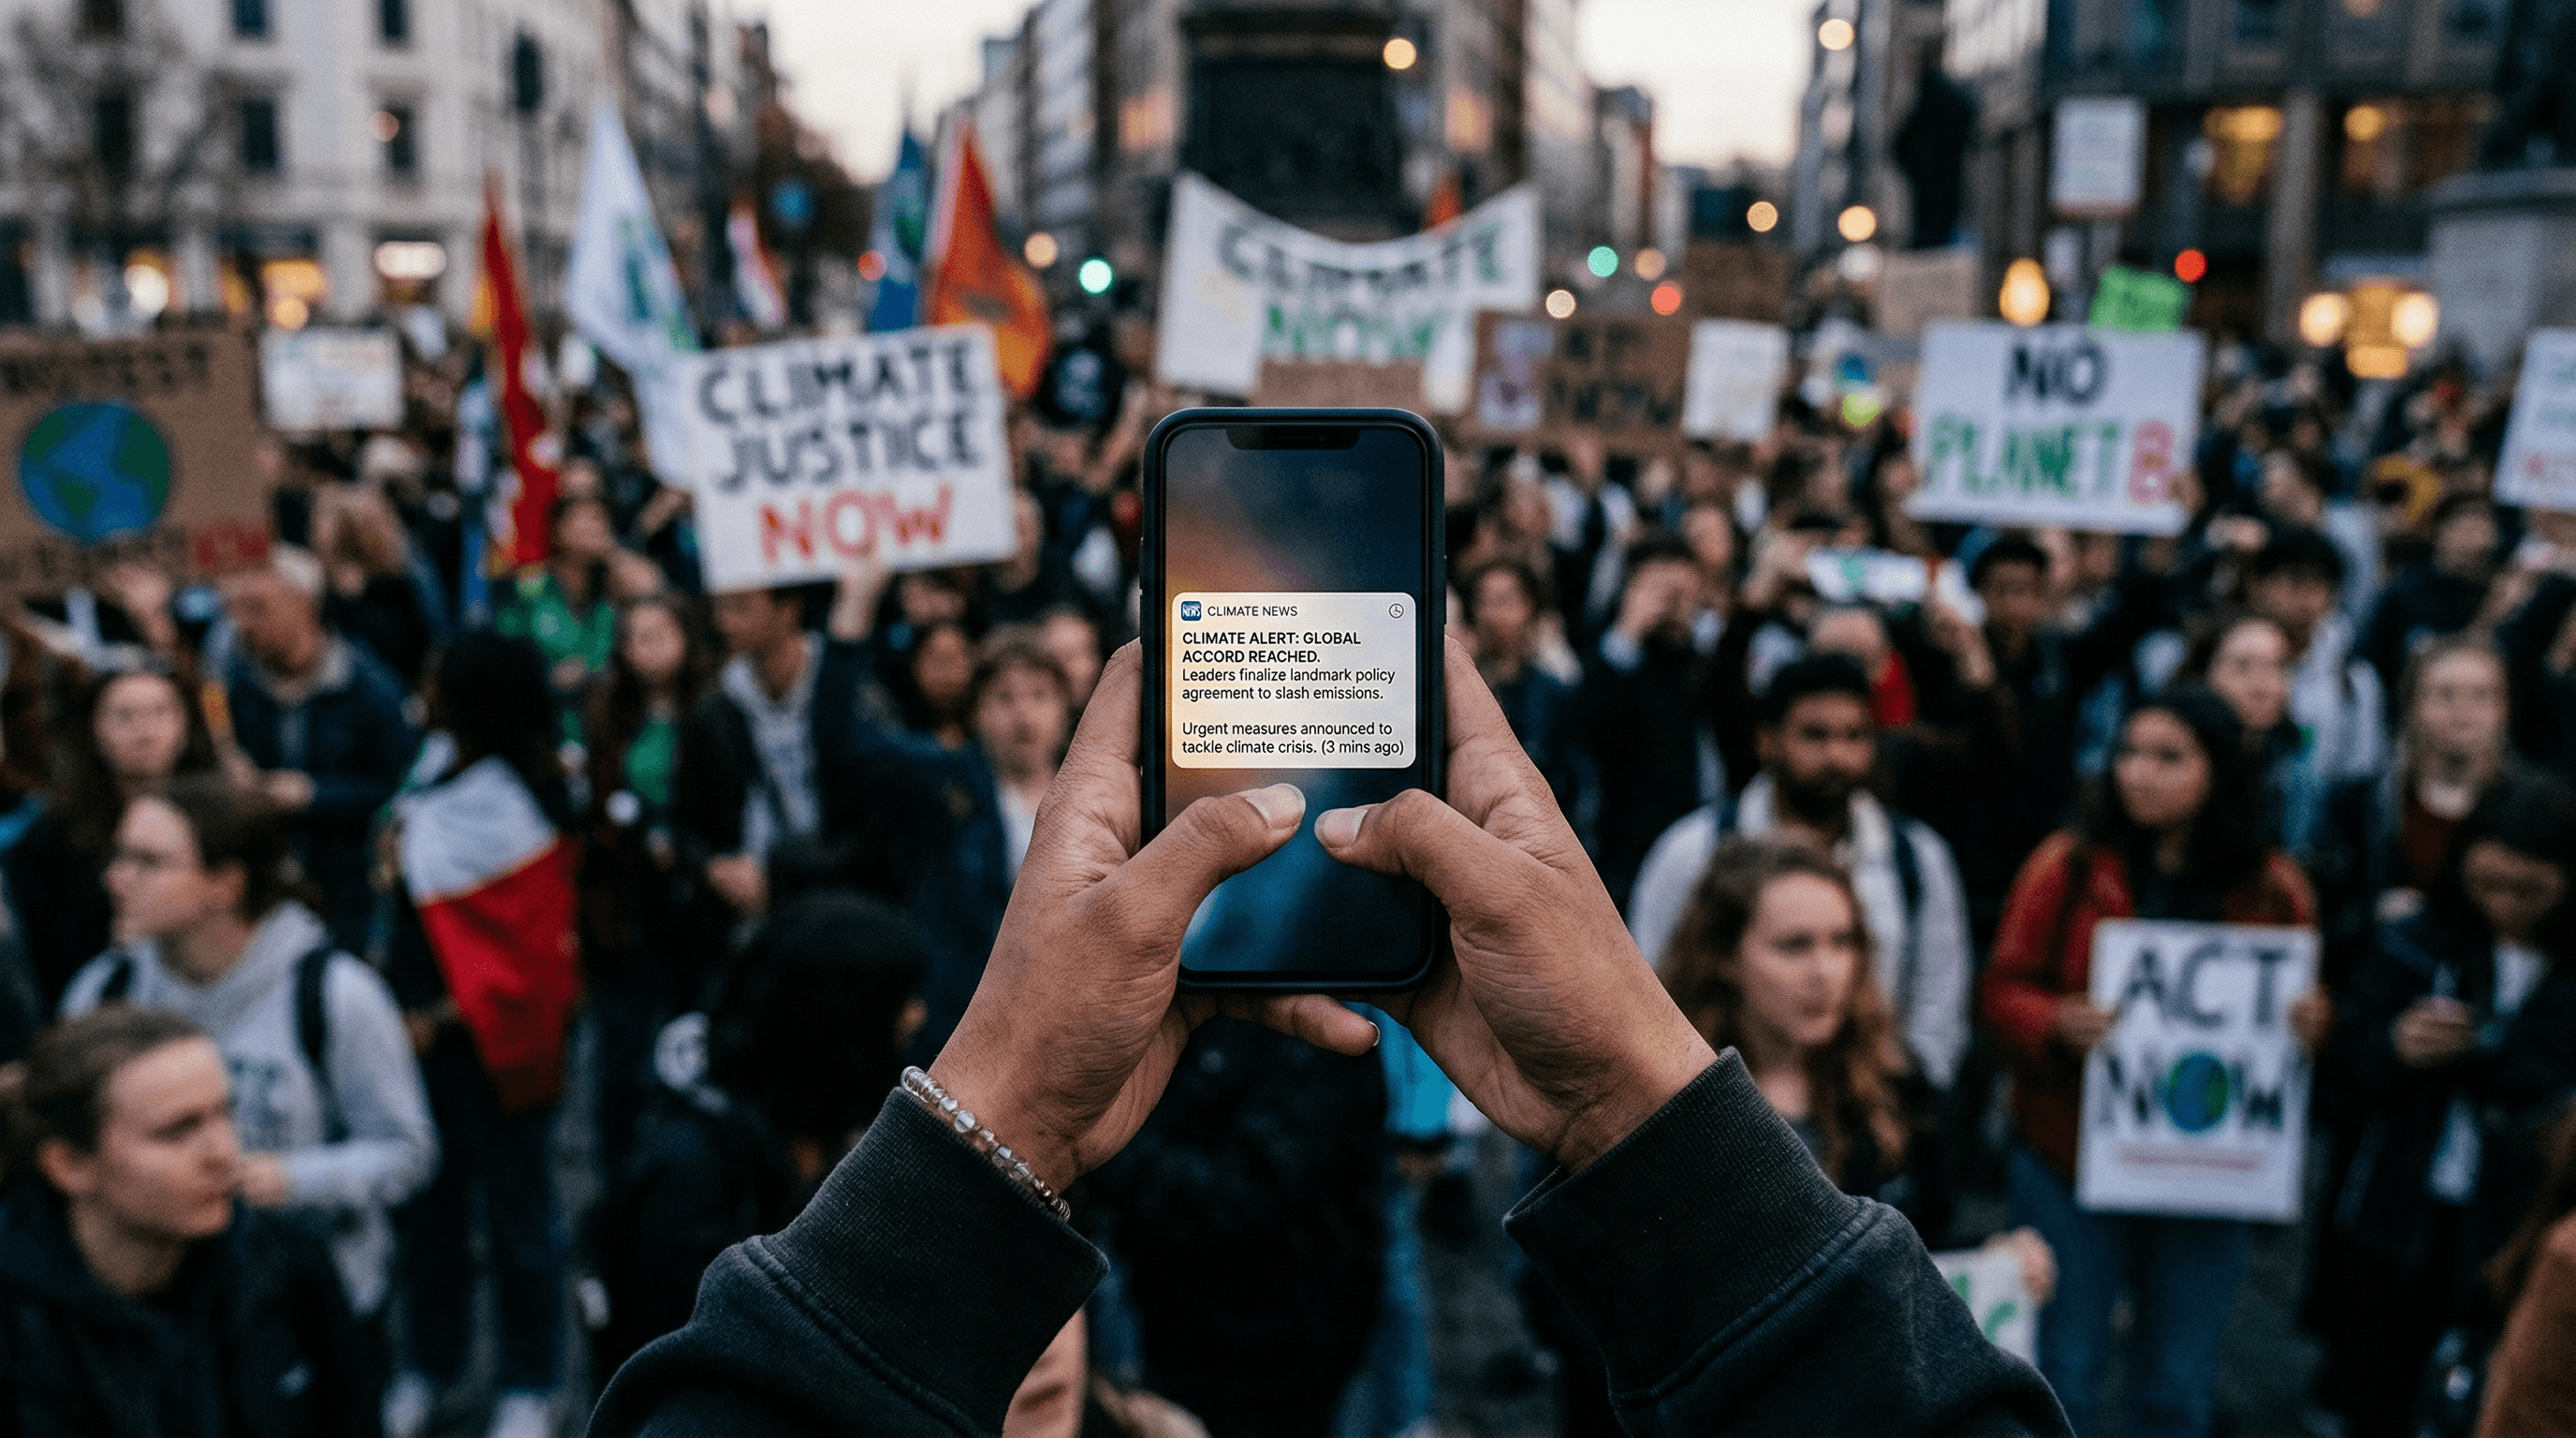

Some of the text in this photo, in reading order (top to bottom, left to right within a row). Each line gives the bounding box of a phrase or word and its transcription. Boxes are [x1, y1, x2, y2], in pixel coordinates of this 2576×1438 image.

[1217, 219, 1505, 295] CLIMATE
[698, 339, 975, 422] CLIMATE
[2003, 342, 2109, 407] NO
[713, 410, 979, 493] JUSTICE
[1926, 415, 2177, 506] PLANET B
[757, 483, 955, 565] NOW
[1208, 607, 1298, 617] CLIMATE NEWS
[1182, 632, 1362, 645] CLIMATE ALERT: GLOBAL
[1182, 650, 1321, 663] ACCORD REACHED.
[1182, 668, 1396, 684] Leaders finalize landmark policy
[1182, 686, 1383, 702] agreement to slash emissions.
[1182, 722, 1393, 738] Urgent measures announced to
[1182, 740, 1404, 756] tackle climate crisis. (3 mins ago)
[2115, 941, 2291, 1032] ACT
